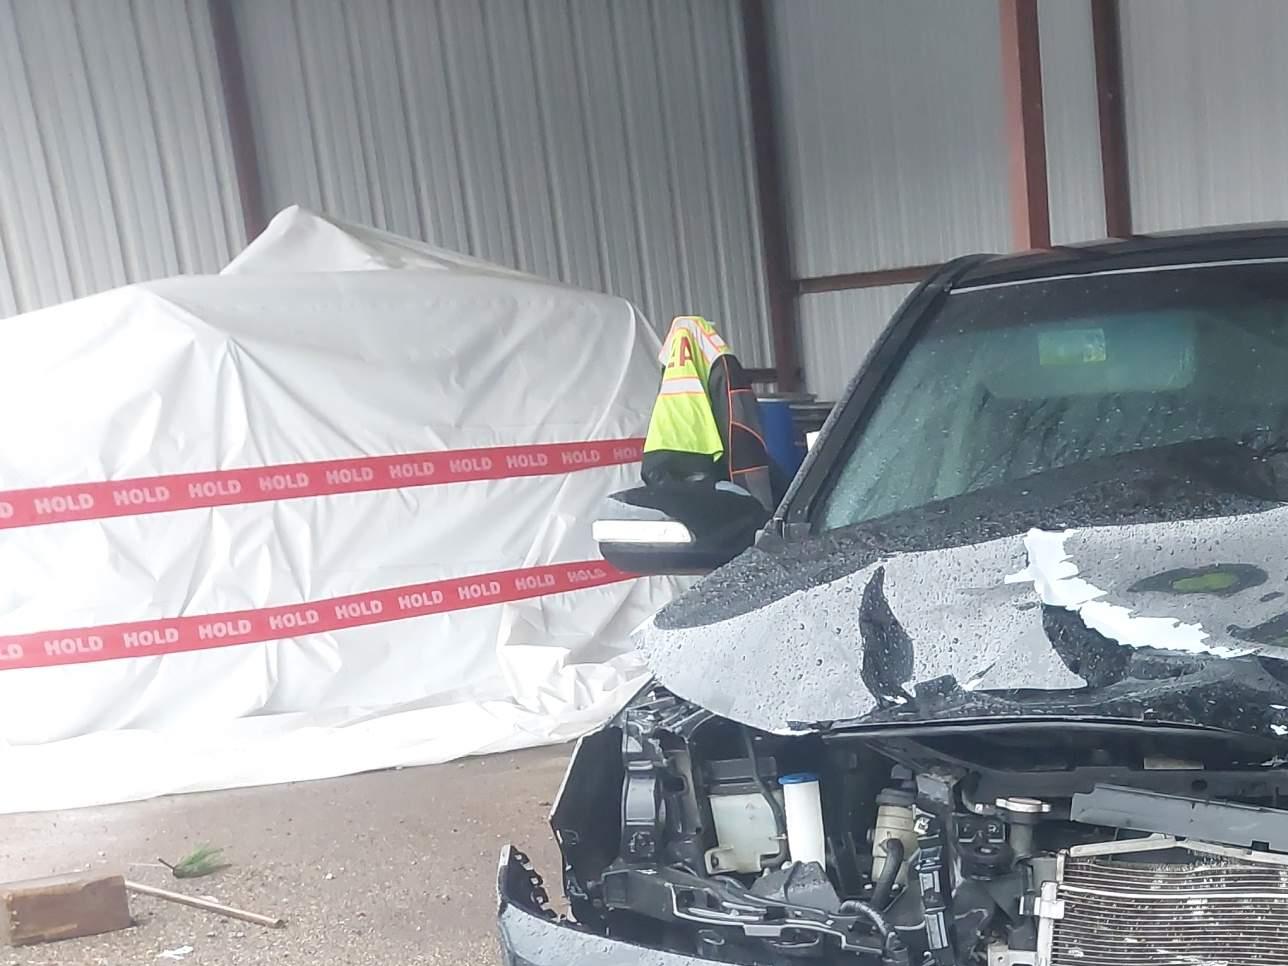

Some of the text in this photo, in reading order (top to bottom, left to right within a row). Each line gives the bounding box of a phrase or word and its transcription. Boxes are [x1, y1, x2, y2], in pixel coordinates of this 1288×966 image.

[34, 493, 94, 514] HOLD
[113, 486, 170, 506] HOLD
[188, 479, 241, 498] HOLD
[259, 472, 309, 491] HOLD
[326, 467, 373, 485] HOLD
[389, 463, 434, 479] HOLD
[449, 458, 492, 473] HOLD
[506, 454, 548, 469] HOLD
[562, 450, 600, 465] HOLD
[44, 636, 103, 656] HOLD
[123, 628, 179, 649] HOLD
[198, 620, 252, 640] HOLD
[268, 610, 319, 630] HOLD
[335, 600, 383, 619] HOLD
[398, 590, 444, 609] HOLD
[458, 581, 501, 600] HOLD
[515, 574, 555, 591] HOLD
